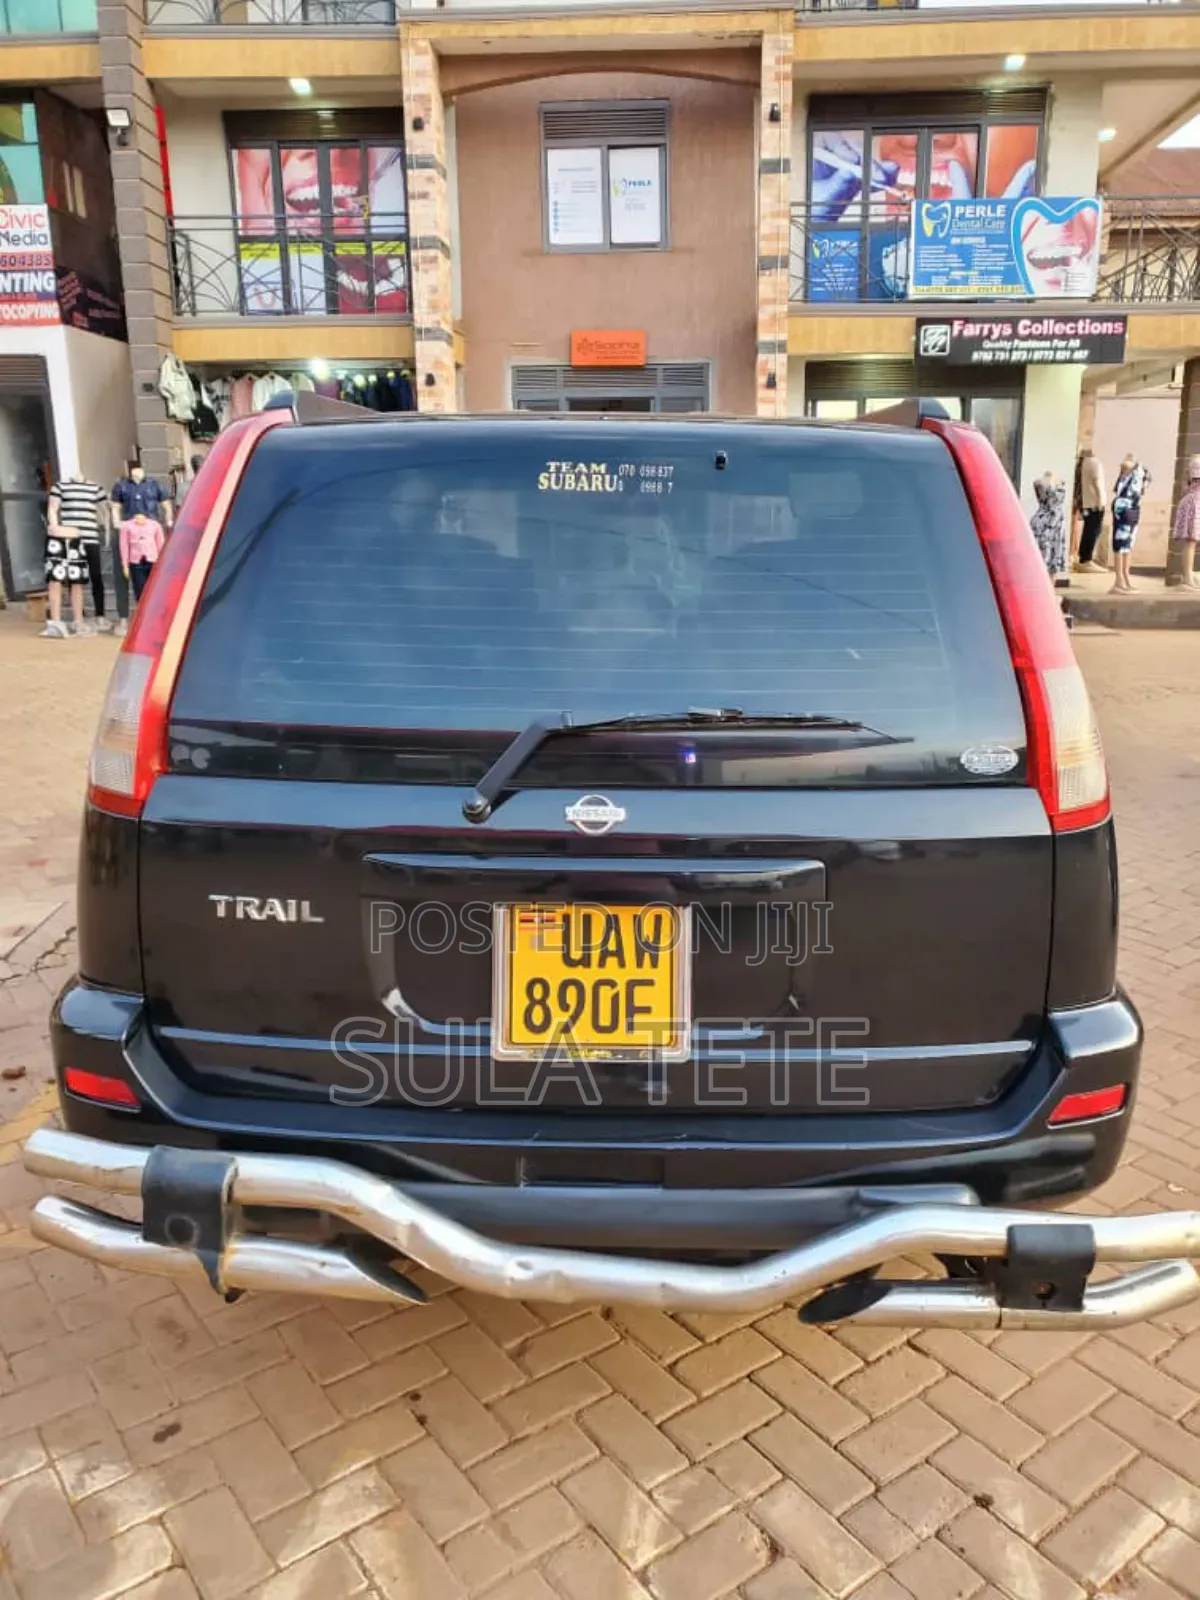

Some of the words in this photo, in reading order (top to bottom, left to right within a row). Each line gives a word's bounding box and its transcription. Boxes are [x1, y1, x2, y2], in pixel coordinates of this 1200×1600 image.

[954, 204, 1006, 218] PERLE
[951, 218, 983, 229] Dental
[952, 319, 1012, 338] Farrys
[1018, 318, 1124, 336] Collections
[546, 461, 607, 474] TEAM
[537, 472, 617, 492] SUBARU
[208, 895, 324, 922] TRAIL
[561, 913, 663, 968] UAW
